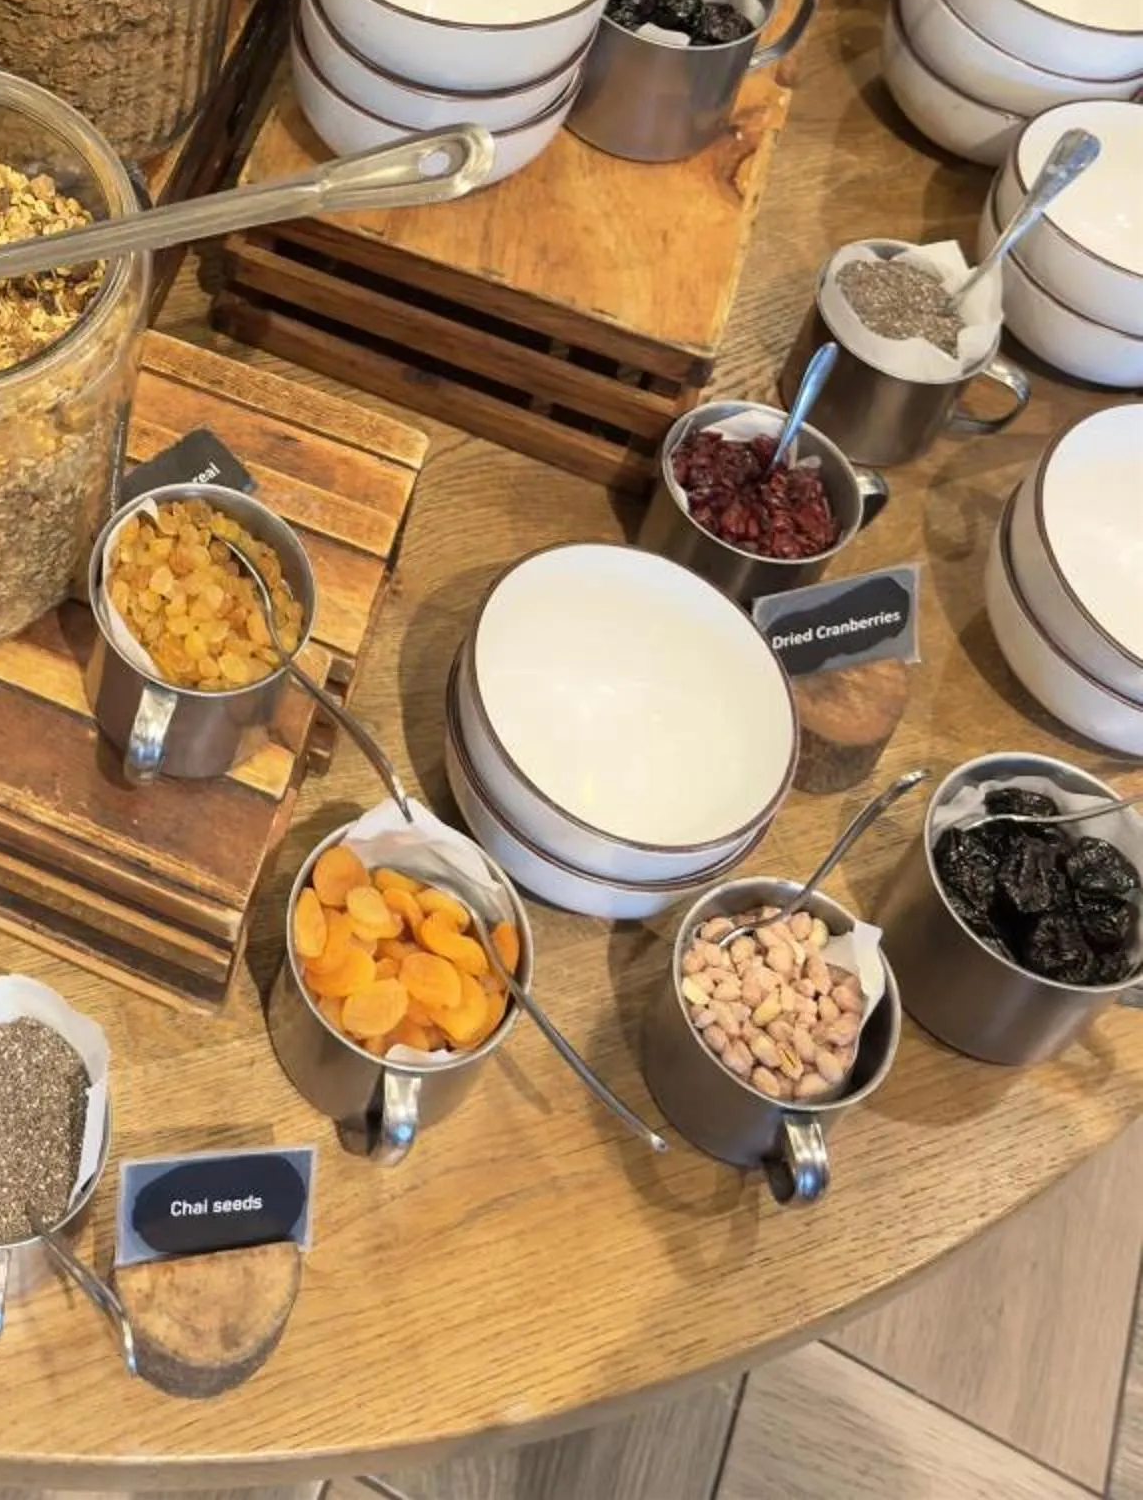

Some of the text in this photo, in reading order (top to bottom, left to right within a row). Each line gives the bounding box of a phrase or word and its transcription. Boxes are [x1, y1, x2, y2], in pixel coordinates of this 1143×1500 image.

[771, 611, 901, 650] Dried Cranberries
[212, 1194, 263, 1213] seeds
